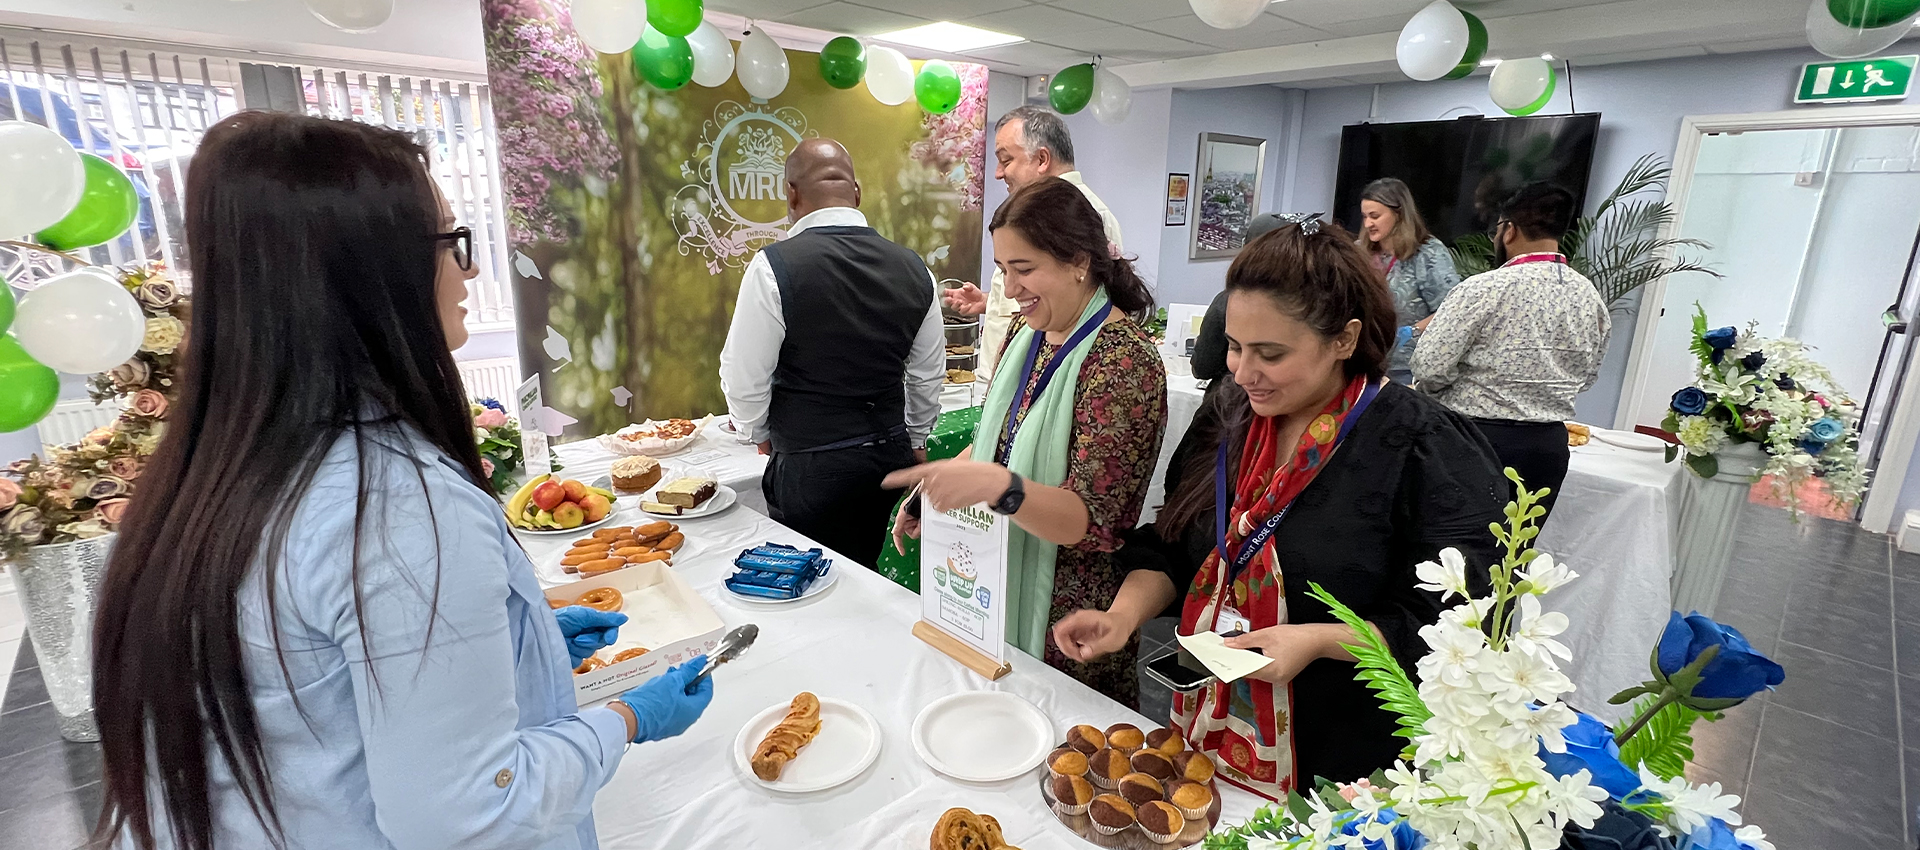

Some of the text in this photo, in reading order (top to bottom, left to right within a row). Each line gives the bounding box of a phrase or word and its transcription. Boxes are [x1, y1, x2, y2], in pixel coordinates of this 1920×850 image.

[697, 217, 725, 256] EXCELLENCE
[958, 513, 990, 532] SUPPORT
[1237, 544, 1256, 565] MONT
[1251, 527, 1271, 546] ROSE
[964, 580, 974, 590] UP
[580, 682, 597, 690] WANT
[602, 675, 615, 683] HOT
[616, 668, 638, 679] Original
